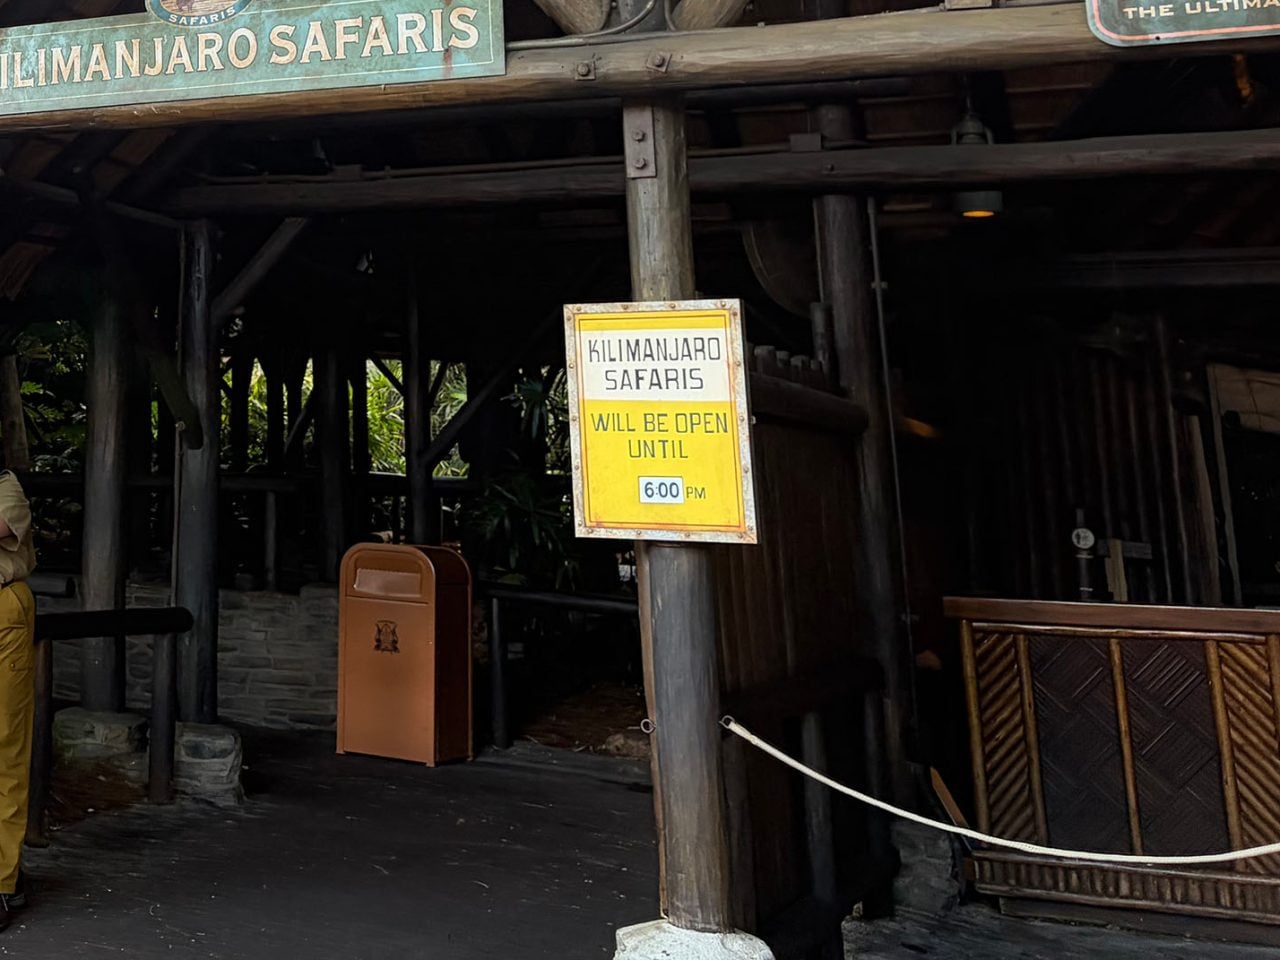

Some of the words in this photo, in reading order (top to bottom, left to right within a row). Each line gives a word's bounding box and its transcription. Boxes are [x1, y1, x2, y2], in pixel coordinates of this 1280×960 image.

[169, 7, 235, 25] SAFARIS
[1123, 5, 1174, 19] THE
[269, 7, 481, 66] SAFARIS
[589, 337, 720, 362] KILIMANJARO
[605, 368, 703, 390] SAFARIS
[591, 413, 636, 432] WILL
[644, 413, 668, 432] BE
[676, 413, 728, 433] OPEN
[628, 440, 688, 458] UNTIL
[644, 482, 680, 498] 6:00
[686, 487, 706, 499] PM
